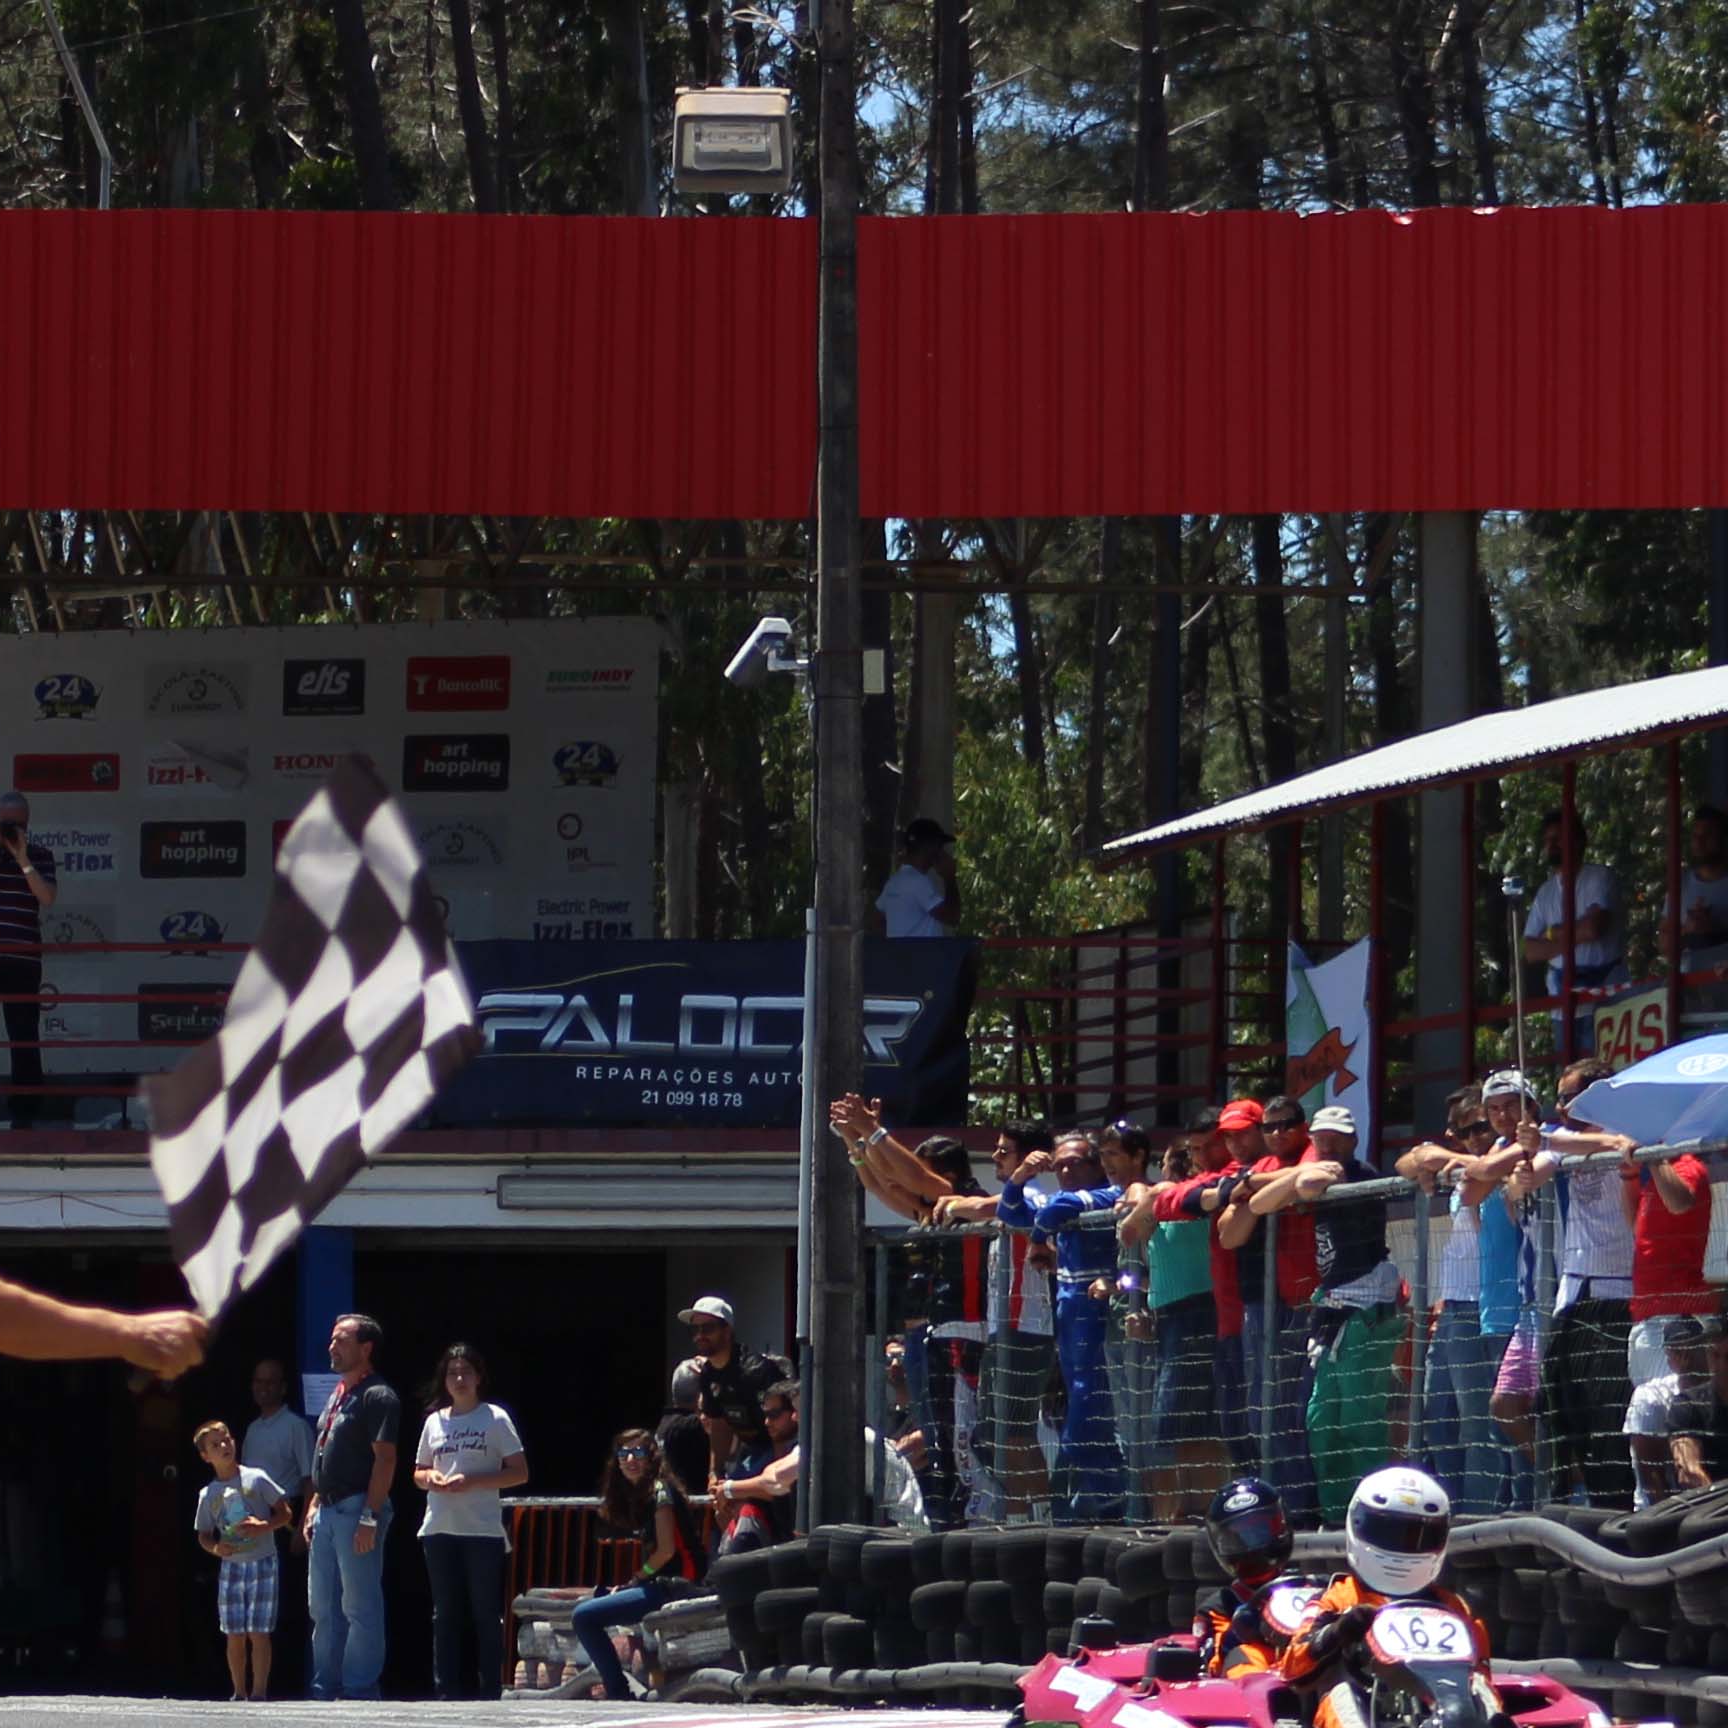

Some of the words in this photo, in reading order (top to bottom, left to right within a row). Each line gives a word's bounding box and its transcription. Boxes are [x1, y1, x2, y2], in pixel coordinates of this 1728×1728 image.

[437, 679, 503, 693] BancoBIC
[547, 669, 634, 683] EUROINDY
[43, 677, 81, 701] 24
[563, 744, 601, 769] 24
[71, 831, 112, 848] Power
[536, 899, 585, 916] Electric
[589, 899, 632, 916] Power
[169, 914, 206, 938] 24
[533, 921, 633, 943] Izzi-Flex
[44, 1016, 70, 1033] IPL
[476, 992, 924, 1064] PALOCR
[1596, 1003, 1665, 1067] GAS
[575, 1064, 736, 1087] REPARAÇÕES
[641, 1089, 660, 1106] 21
[666, 1089, 695, 1107] 099
[699, 1089, 719, 1107] 18
[723, 1090, 744, 1108] 78
[1387, 1616, 1458, 1652] 162
